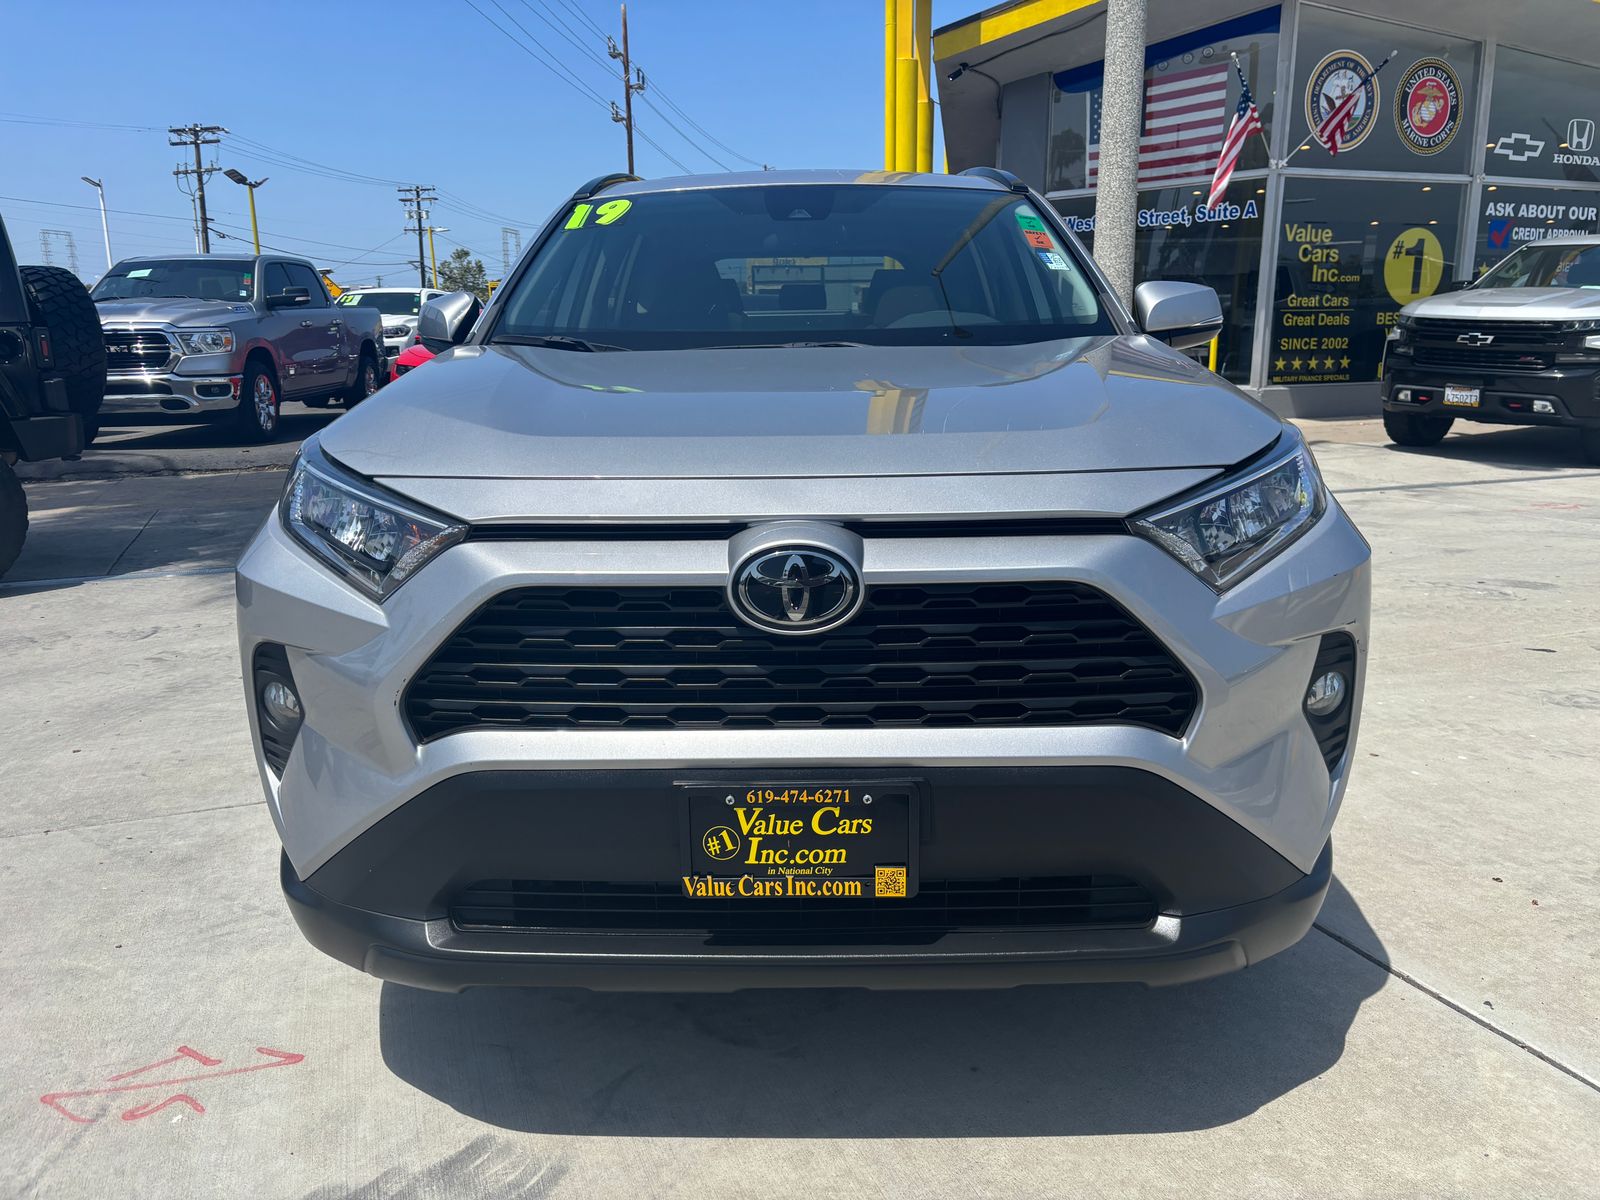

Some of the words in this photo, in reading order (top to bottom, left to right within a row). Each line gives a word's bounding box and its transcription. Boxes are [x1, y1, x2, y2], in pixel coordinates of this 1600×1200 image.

[1405, 67, 1436, 93] UNITED
[1436, 68, 1457, 106] STATES
[1401, 118, 1429, 147] MARINE
[1430, 120, 1455, 146] CORPS
[1553, 153, 1600, 166] HONDA
[564, 199, 633, 230] 19
[1138, 206, 1192, 227] Street,
[1196, 203, 1239, 222] Suite
[1242, 200, 1259, 219] A
[1485, 202, 1516, 217] ASK
[1518, 204, 1566, 219] ABOUT
[1568, 206, 1597, 220] OUR
[1285, 223, 1333, 243] Value
[1512, 226, 1545, 240] CREDIT
[1298, 244, 1340, 263] Cars
[1312, 264, 1360, 283] Inc.com
[1287, 293, 1319, 307] Great
[1322, 294, 1350, 307] Cars
[1283, 313, 1315, 326] Great
[1318, 313, 1351, 326] Deals
[1280, 337, 1318, 350] SINCE
[1321, 337, 1349, 349] 2002
[746, 789, 850, 804] 619-474-6271
[734, 807, 804, 836] Value
[811, 806, 873, 836] Cars
[707, 829, 737, 856] #1
[744, 837, 847, 864] Inc.com
[767, 867, 776, 875] in
[778, 866, 813, 875] National
[814, 866, 833, 876] City
